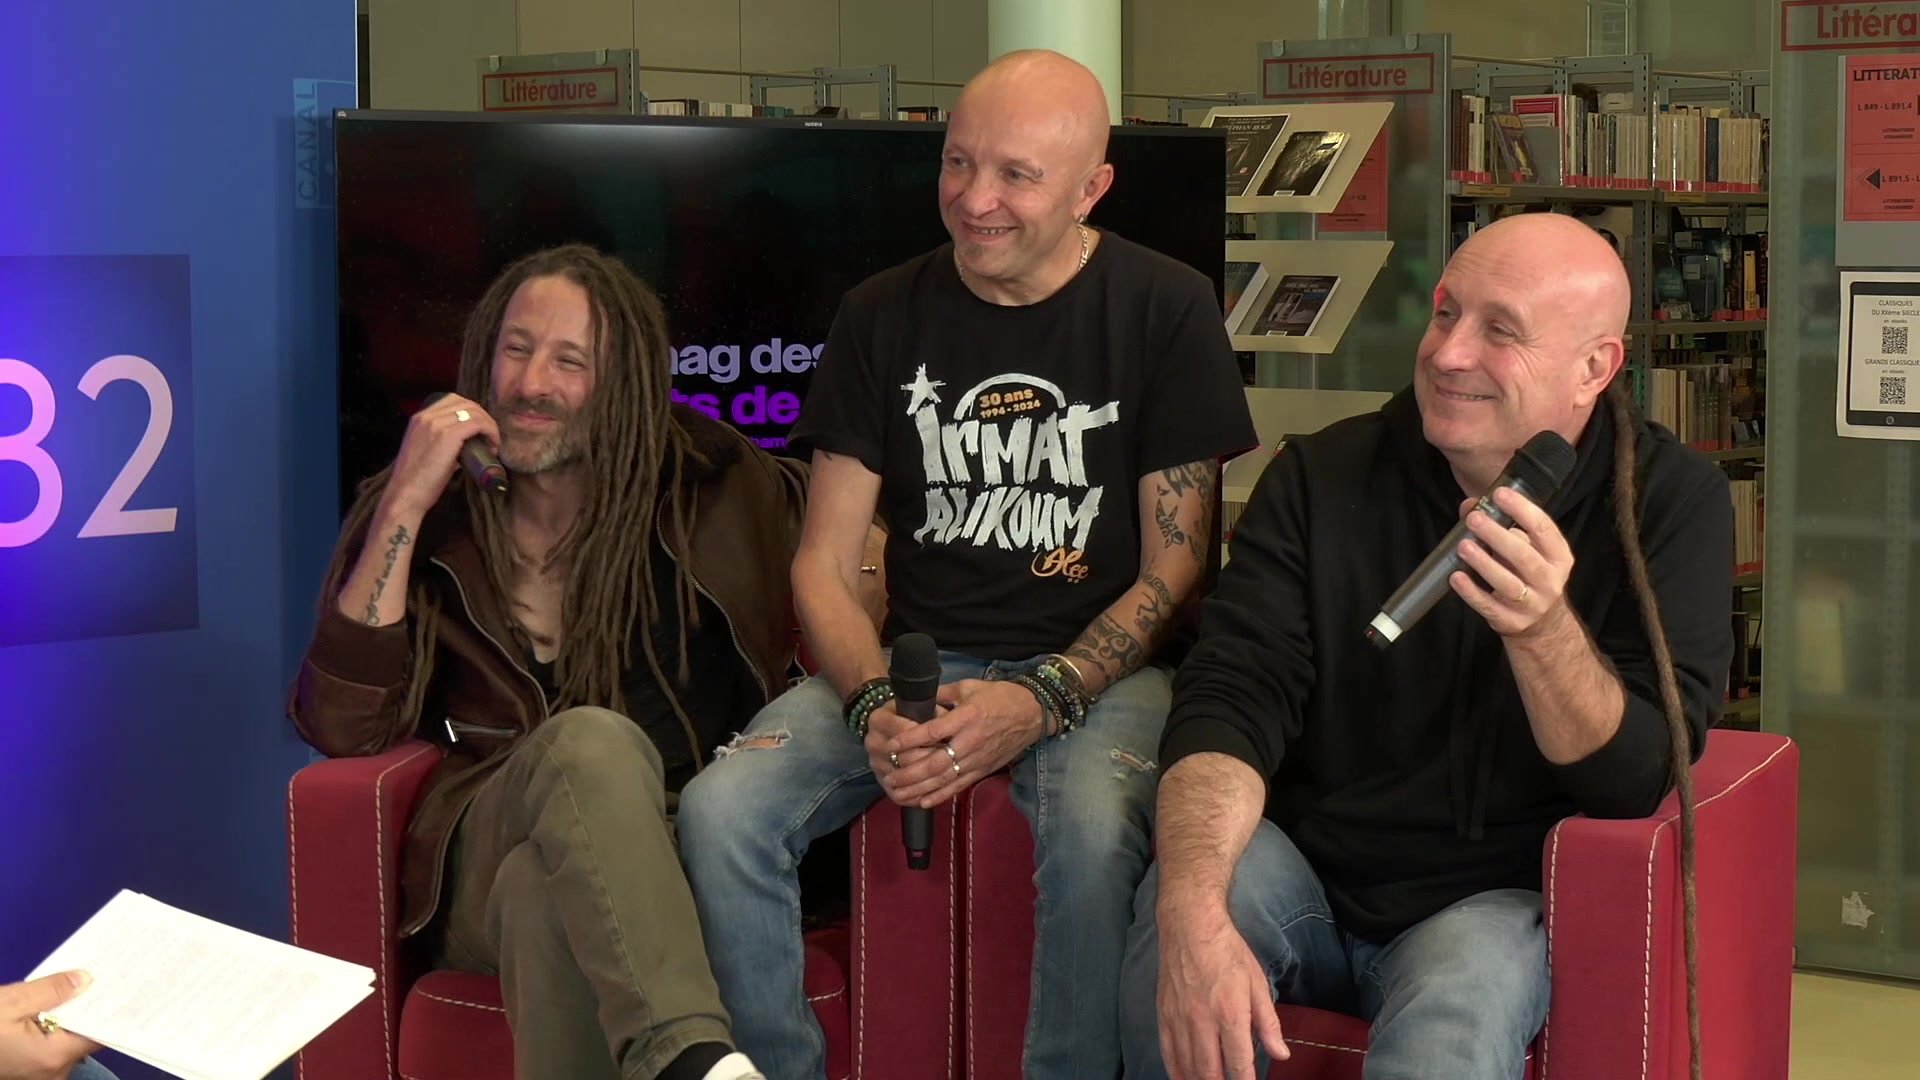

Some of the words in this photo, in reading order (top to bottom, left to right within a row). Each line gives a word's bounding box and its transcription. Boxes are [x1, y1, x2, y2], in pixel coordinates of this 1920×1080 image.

[1287, 63, 1408, 90] Littérature
[502, 78, 598, 104] Littérature
[296, 80, 318, 201] CANAL
[1878, 299, 1913, 307] CLASSIQUES
[732, 385, 800, 425] de
[979, 392, 1001, 408] 30
[1003, 388, 1034, 403] ans
